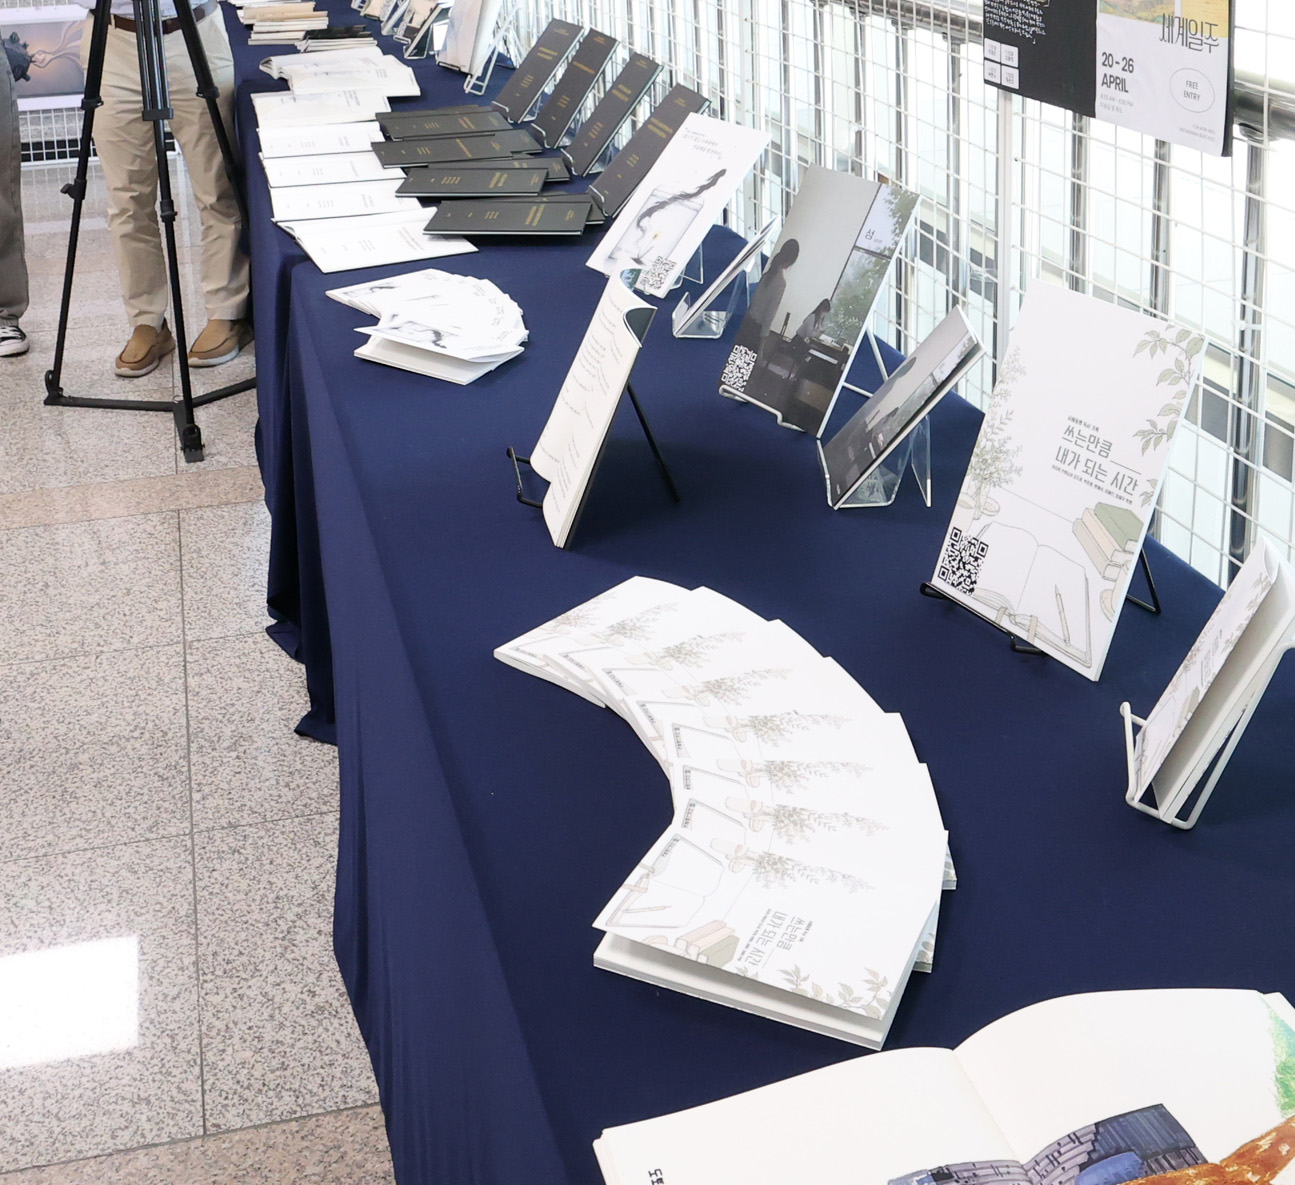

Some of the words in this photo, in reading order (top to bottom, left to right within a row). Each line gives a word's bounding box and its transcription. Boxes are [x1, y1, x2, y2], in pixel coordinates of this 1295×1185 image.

[1160, 13, 1220, 54] 세계일주
[1102, 52, 1114, 68] 20
[1122, 56, 1134, 74] 26
[1101, 72, 1129, 93] APRIL
[1186, 80, 1199, 90] FREE
[1184, 90, 1200, 101] ENTRY
[1061, 425, 1112, 458] 쓰는만큼
[1056, 446, 1080, 470] 내가
[1082, 458, 1108, 483] 되는
[1111, 472, 1138, 496] 시간
[767, 911, 788, 928] 내가
[755, 928, 776, 946] 되는
[776, 916, 805, 950] 쓰는만큼
[745, 946, 765, 966] 시간
